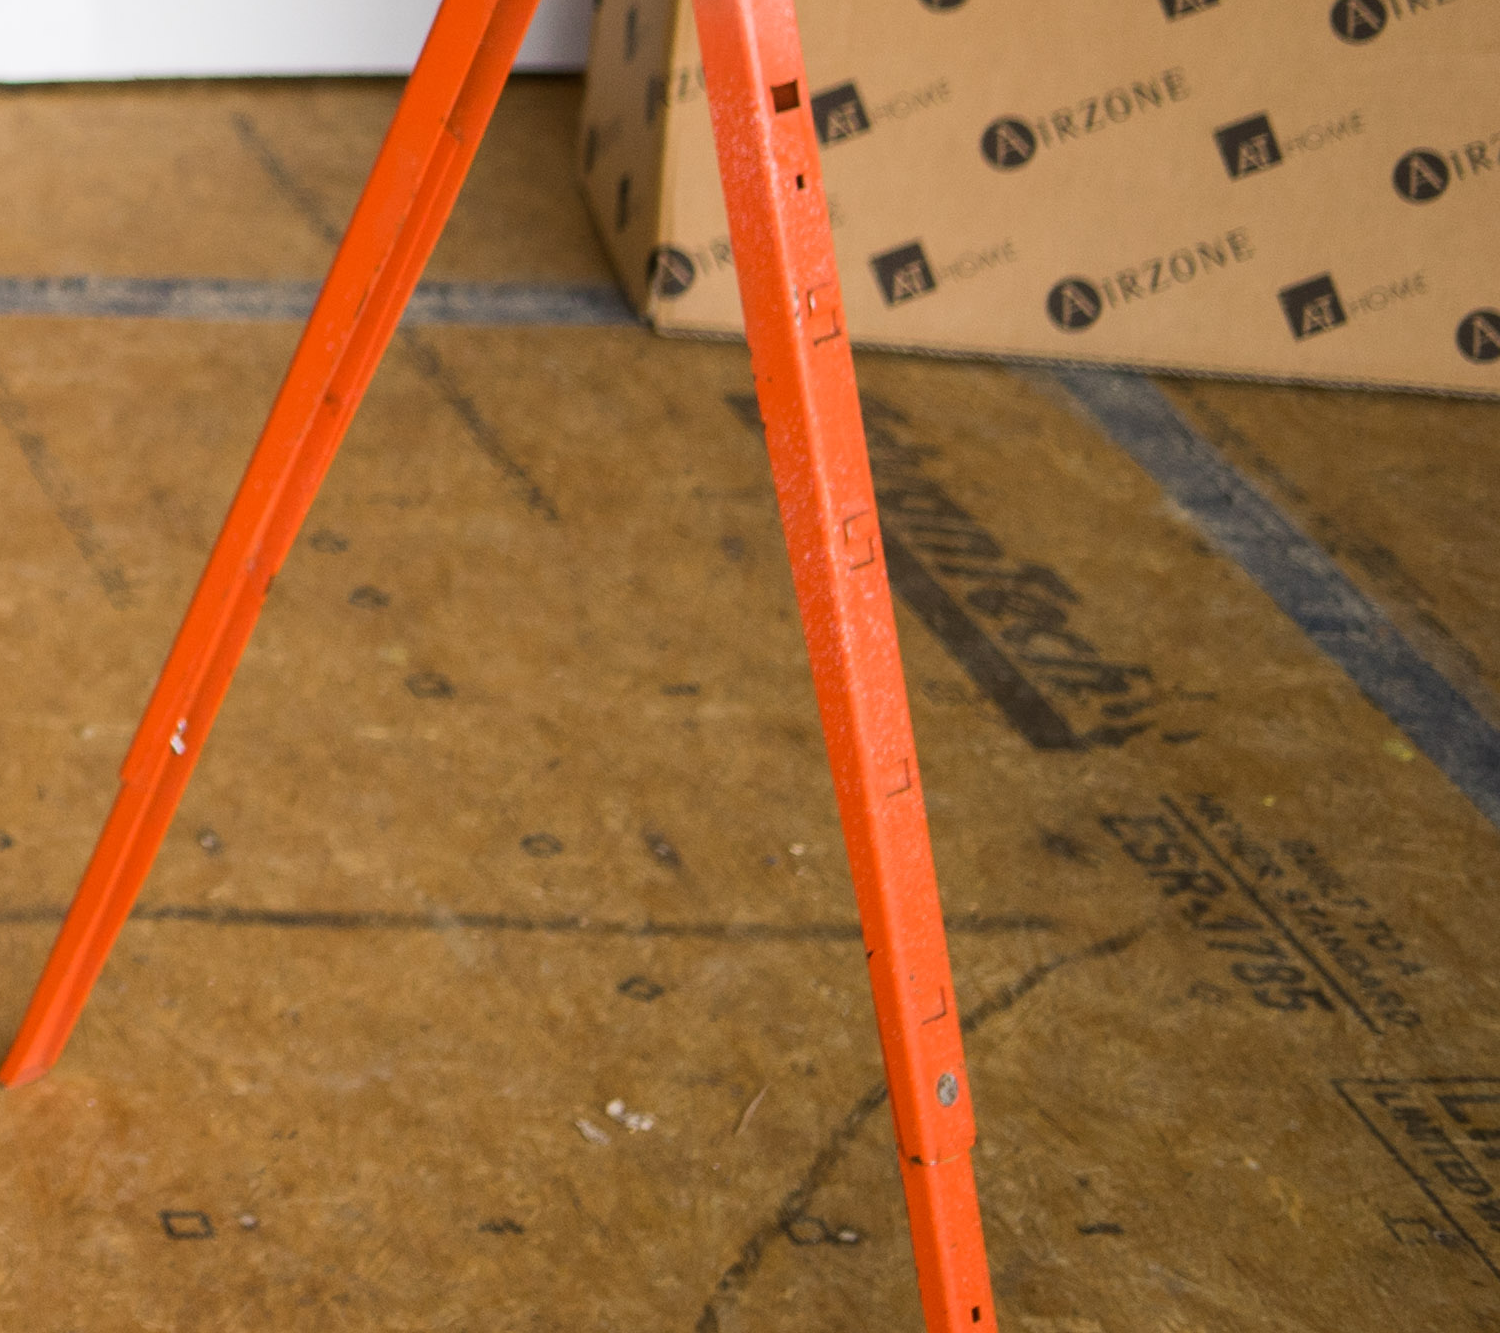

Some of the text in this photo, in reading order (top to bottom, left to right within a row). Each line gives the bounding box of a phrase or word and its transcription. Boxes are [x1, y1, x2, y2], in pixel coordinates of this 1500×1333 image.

[869, 79, 953, 123] HOME
[979, 66, 1192, 172] AIRZONE
[1283, 109, 1366, 155] HOME
[1044, 226, 1257, 334] AIRZONE
[1346, 272, 1429, 319] HOME
